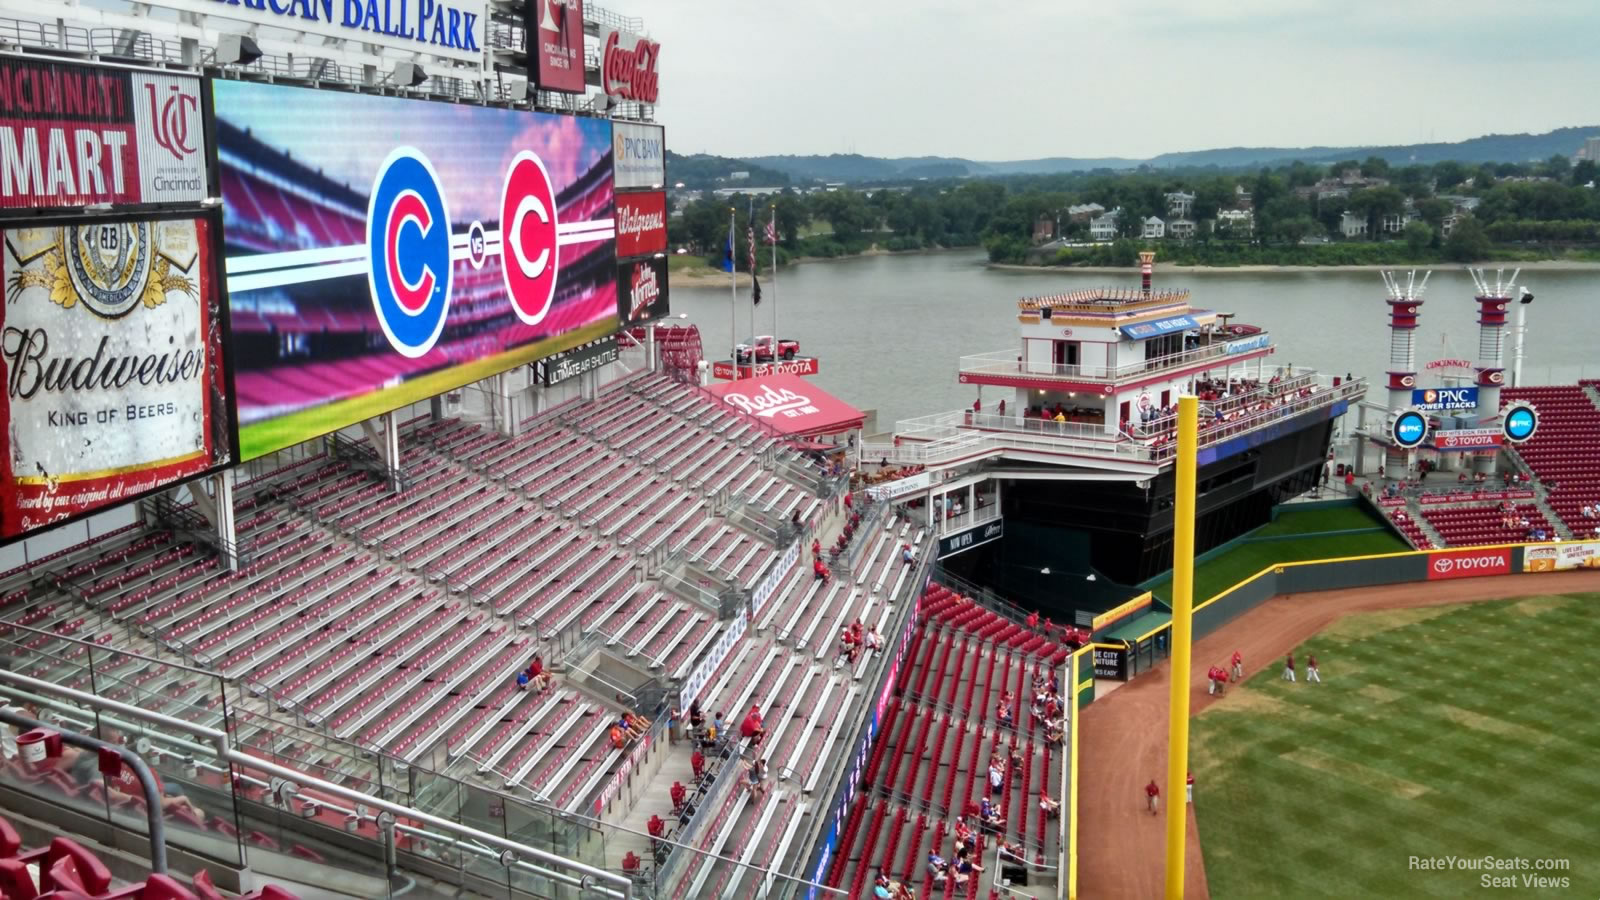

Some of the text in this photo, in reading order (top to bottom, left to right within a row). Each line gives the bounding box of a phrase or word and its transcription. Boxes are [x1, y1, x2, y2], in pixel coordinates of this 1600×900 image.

[624, 137, 661, 160] PNC BANK
[0, 126, 127, 197] MART
[153, 176, 201, 191] Cincinnati
[617, 204, 664, 242] Walgreens
[472, 237, 484, 254] VS
[2, 326, 205, 400] Budweiser
[549, 348, 617, 385] ULTIMATE AIR SHUTTLE
[1426, 359, 1472, 370] CINCINNATI
[724, 384, 811, 416] Reds
[1438, 389, 1469, 403] PNC
[1446, 401, 1476, 410] STACKS
[48, 410, 88, 427] KING
[96, 408, 118, 423] OF
[1459, 436, 1493, 445] TOYOTA
[1455, 556, 1505, 570] TOYOTA
[1103, 651, 1118, 659] CITY
